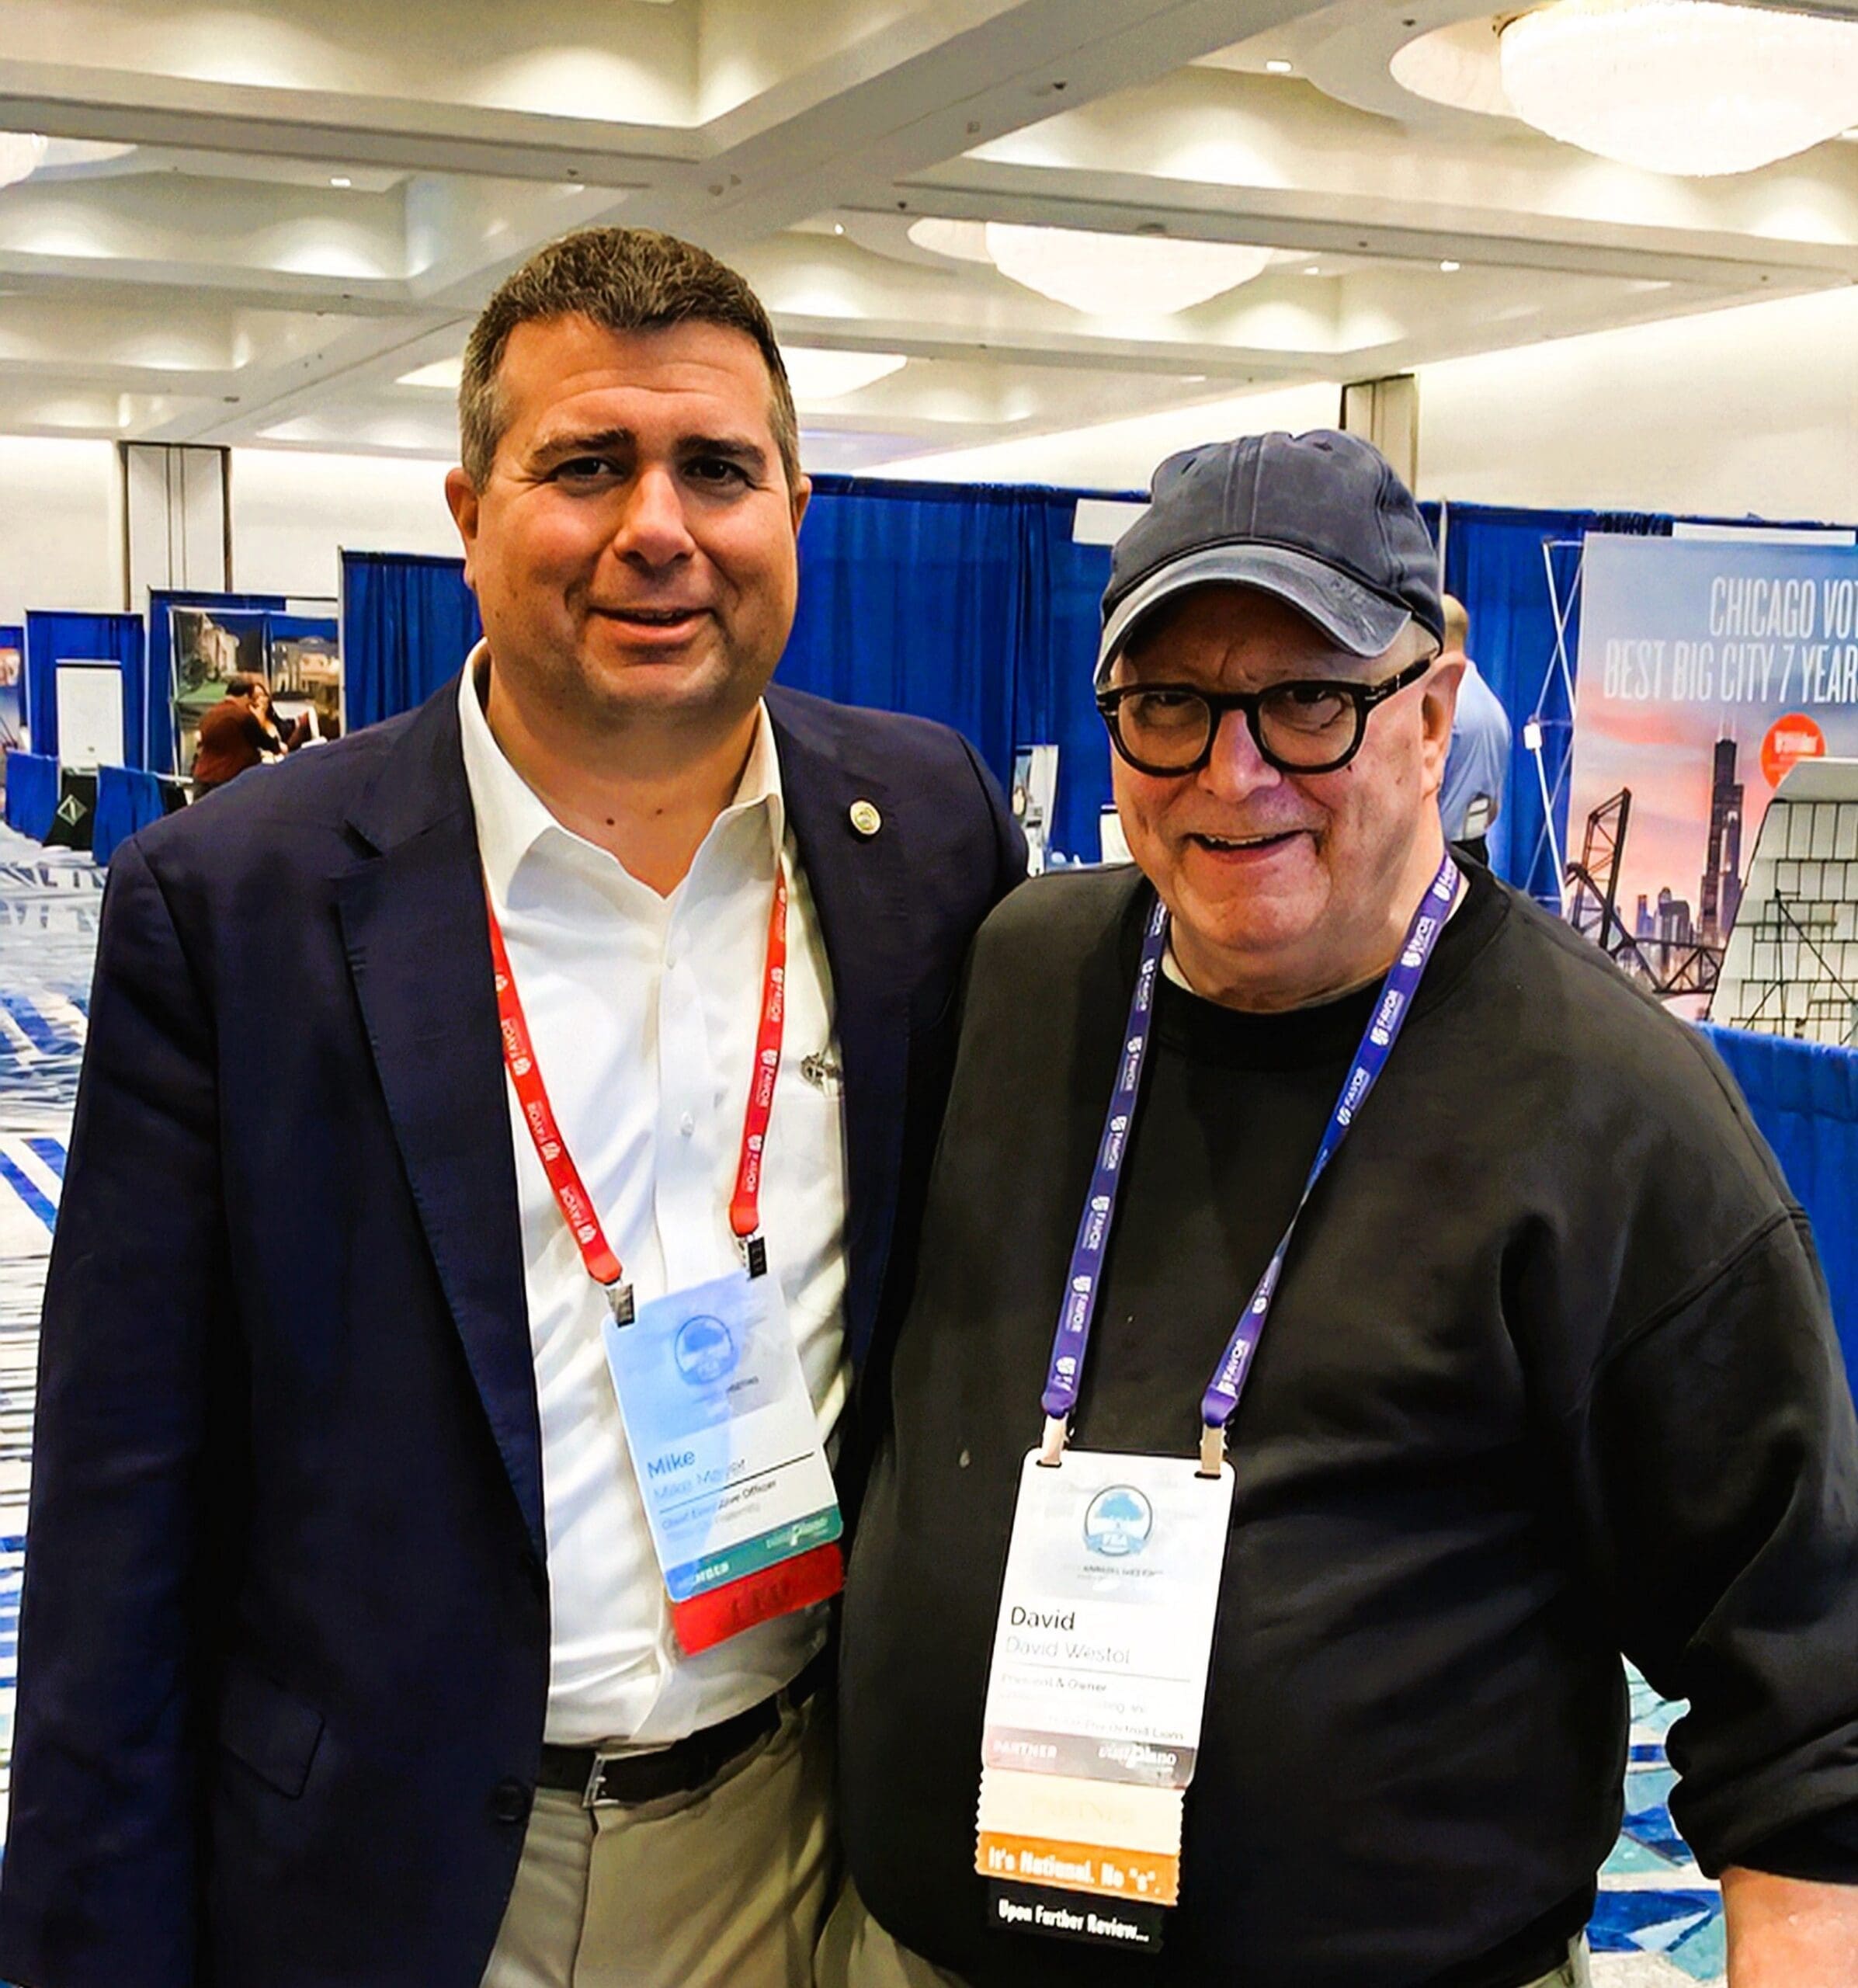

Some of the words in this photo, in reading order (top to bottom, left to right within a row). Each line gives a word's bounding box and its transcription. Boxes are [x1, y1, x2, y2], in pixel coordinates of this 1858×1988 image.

[1710, 576, 1816, 639] CHICAGO
[1603, 638, 1666, 699] BEST
[1672, 640, 1714, 701] BIG
[1720, 642, 1775, 702] CITY
[1779, 644, 1794, 704] 7
[1801, 644, 1858, 704] YEAR
[1376, 989, 1400, 1027] FAVOR
[1344, 1067, 1366, 1107] FAVOR
[559, 1185, 582, 1229] FAVOR
[1221, 1338, 1248, 1382] FAVOR
[647, 1451, 696, 1479] Mike
[1010, 1606, 1075, 1632] David
[1006, 1636, 1058, 1658] David
[1065, 1641, 1130, 1664] Westol
[1068, 1678, 1107, 1691] Owner
[988, 1845, 1016, 1872] It's
[1019, 1850, 1096, 1885] National.
[1101, 1861, 1125, 1889] No
[998, 1898, 1033, 1923] Upon
[1035, 1904, 1085, 1931] Further
[1087, 1913, 1150, 1942] Review...
